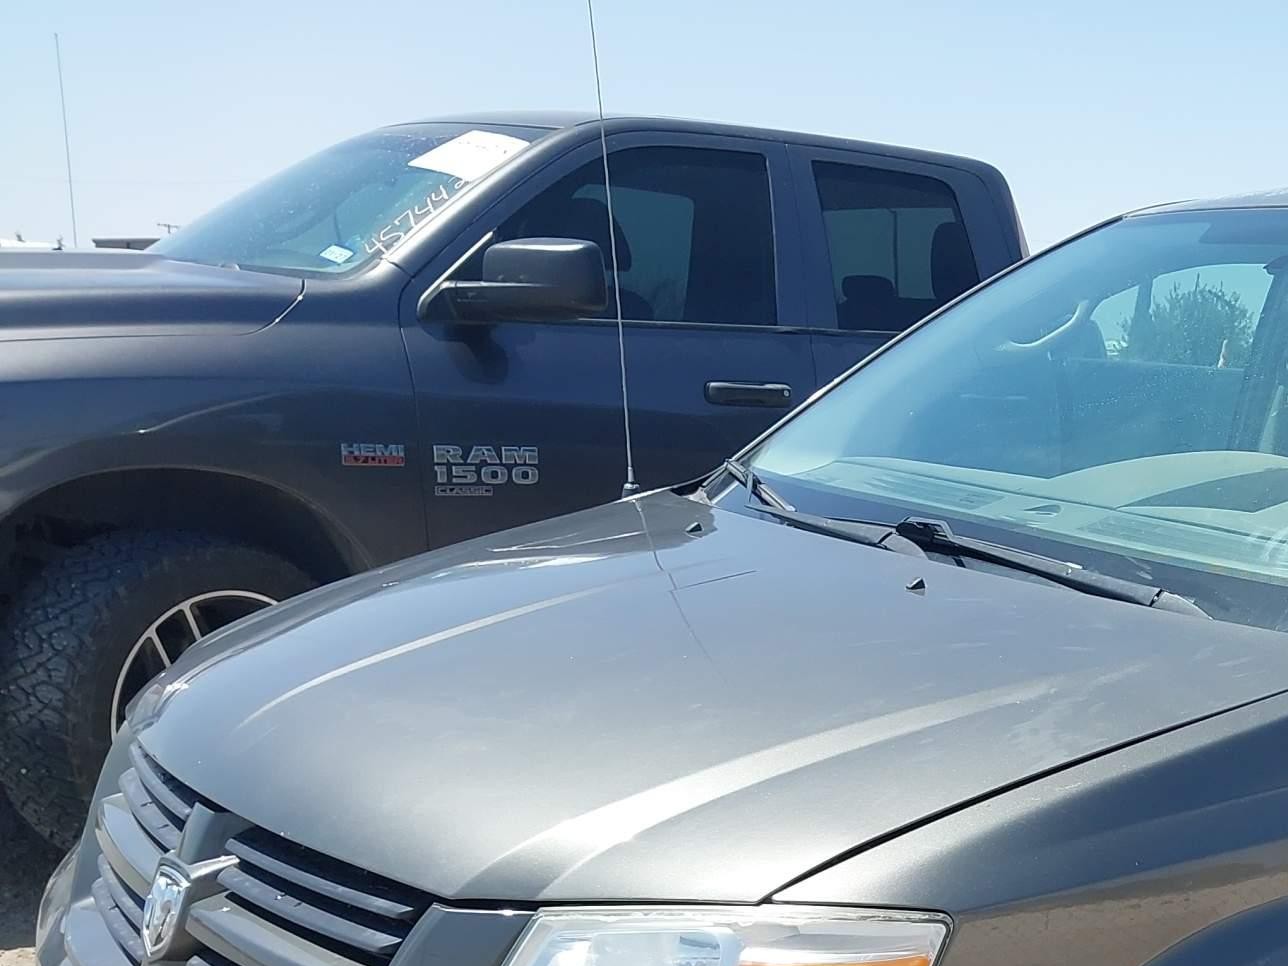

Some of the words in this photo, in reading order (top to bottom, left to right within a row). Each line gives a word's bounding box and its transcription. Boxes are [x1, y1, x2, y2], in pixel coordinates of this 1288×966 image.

[341, 443, 404, 456] HEMI
[433, 445, 539, 464] RAM
[434, 465, 539, 485] 1500
